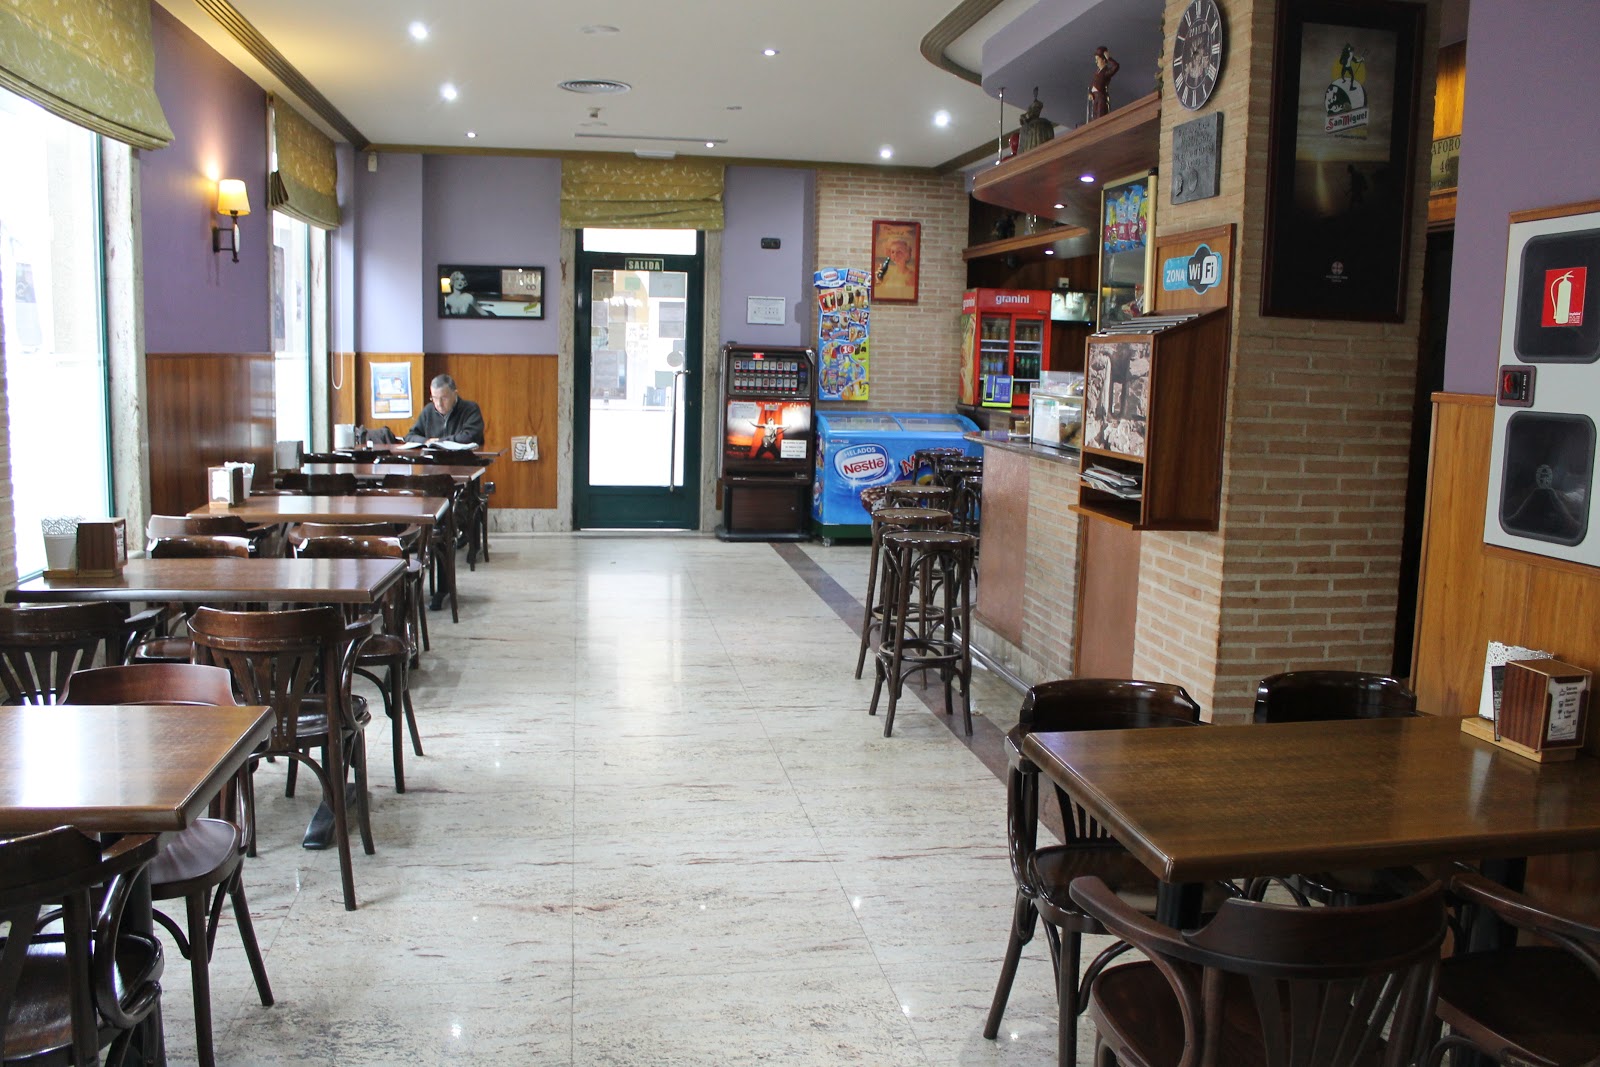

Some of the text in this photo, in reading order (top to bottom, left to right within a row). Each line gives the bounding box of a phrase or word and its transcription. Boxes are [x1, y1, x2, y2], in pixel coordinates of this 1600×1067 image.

[1325, 111, 1367, 130] San Miguel
[1431, 137, 1461, 155] AFORO
[628, 260, 660, 270] SALIDA
[1166, 269, 1185, 282] ZONA
[995, 294, 1030, 305] granini
[843, 446, 876, 458] HELADOS
